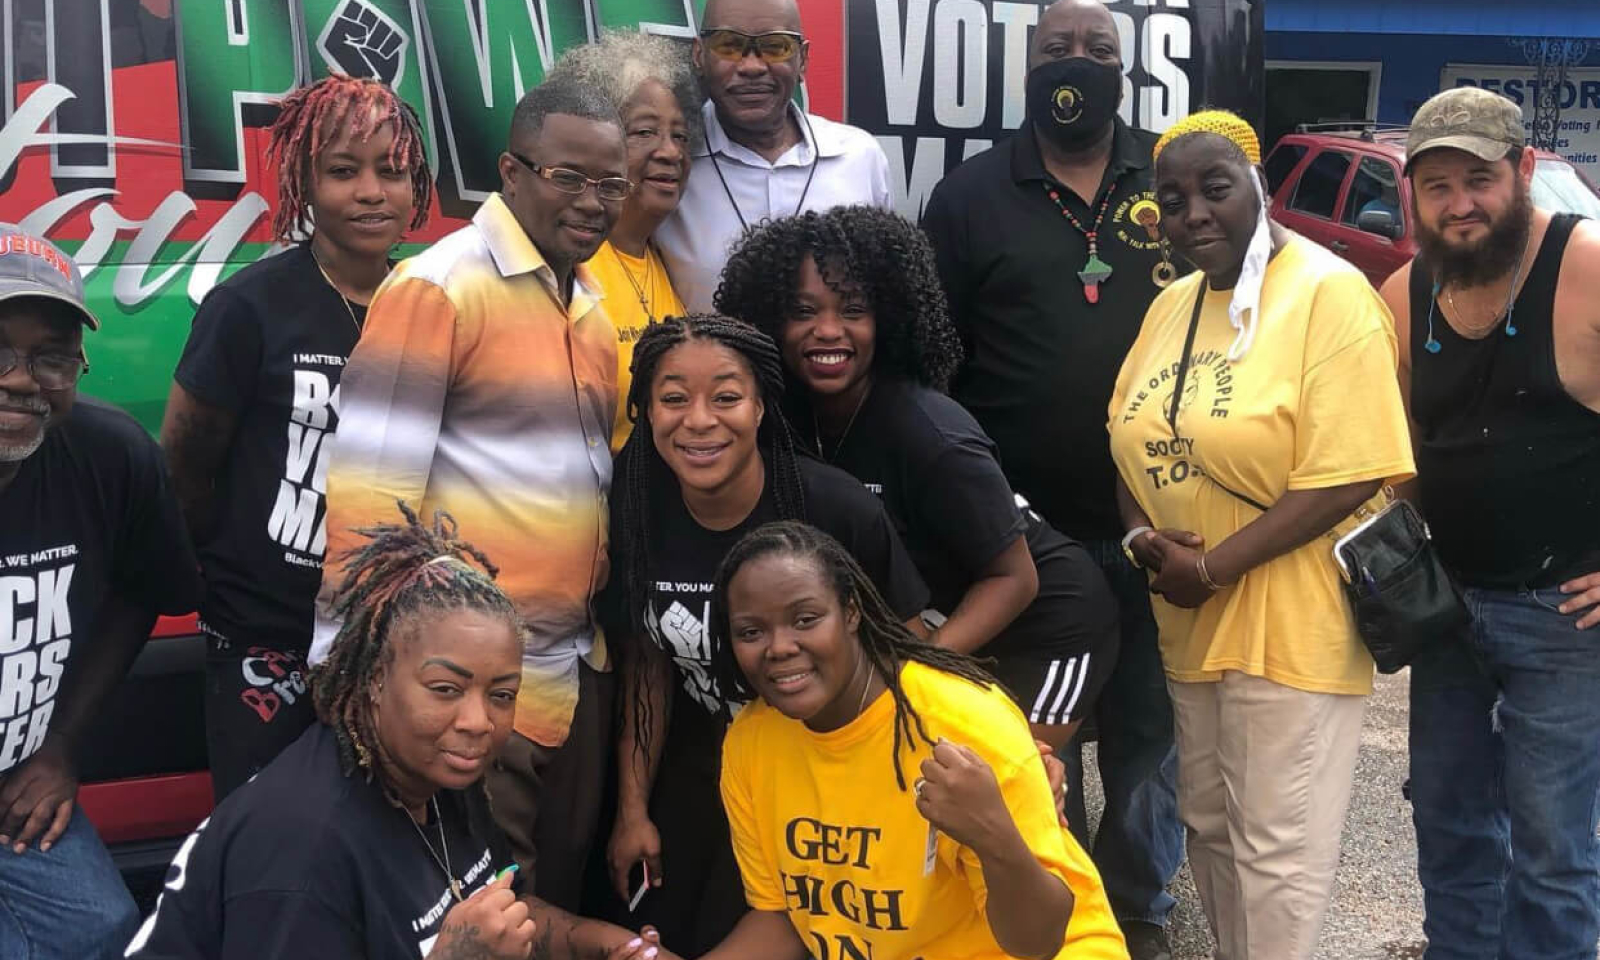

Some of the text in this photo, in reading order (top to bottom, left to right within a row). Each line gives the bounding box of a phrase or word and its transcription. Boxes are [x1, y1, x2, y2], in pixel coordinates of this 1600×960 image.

[873, 0, 1193, 134] VOTS
[1123, 350, 1233, 424] THE ORDNARY PEOPLE
[7, 554, 29, 567] WE
[675, 582, 698, 592] YOU
[785, 817, 881, 870] GET
[779, 869, 909, 931] HIGH
